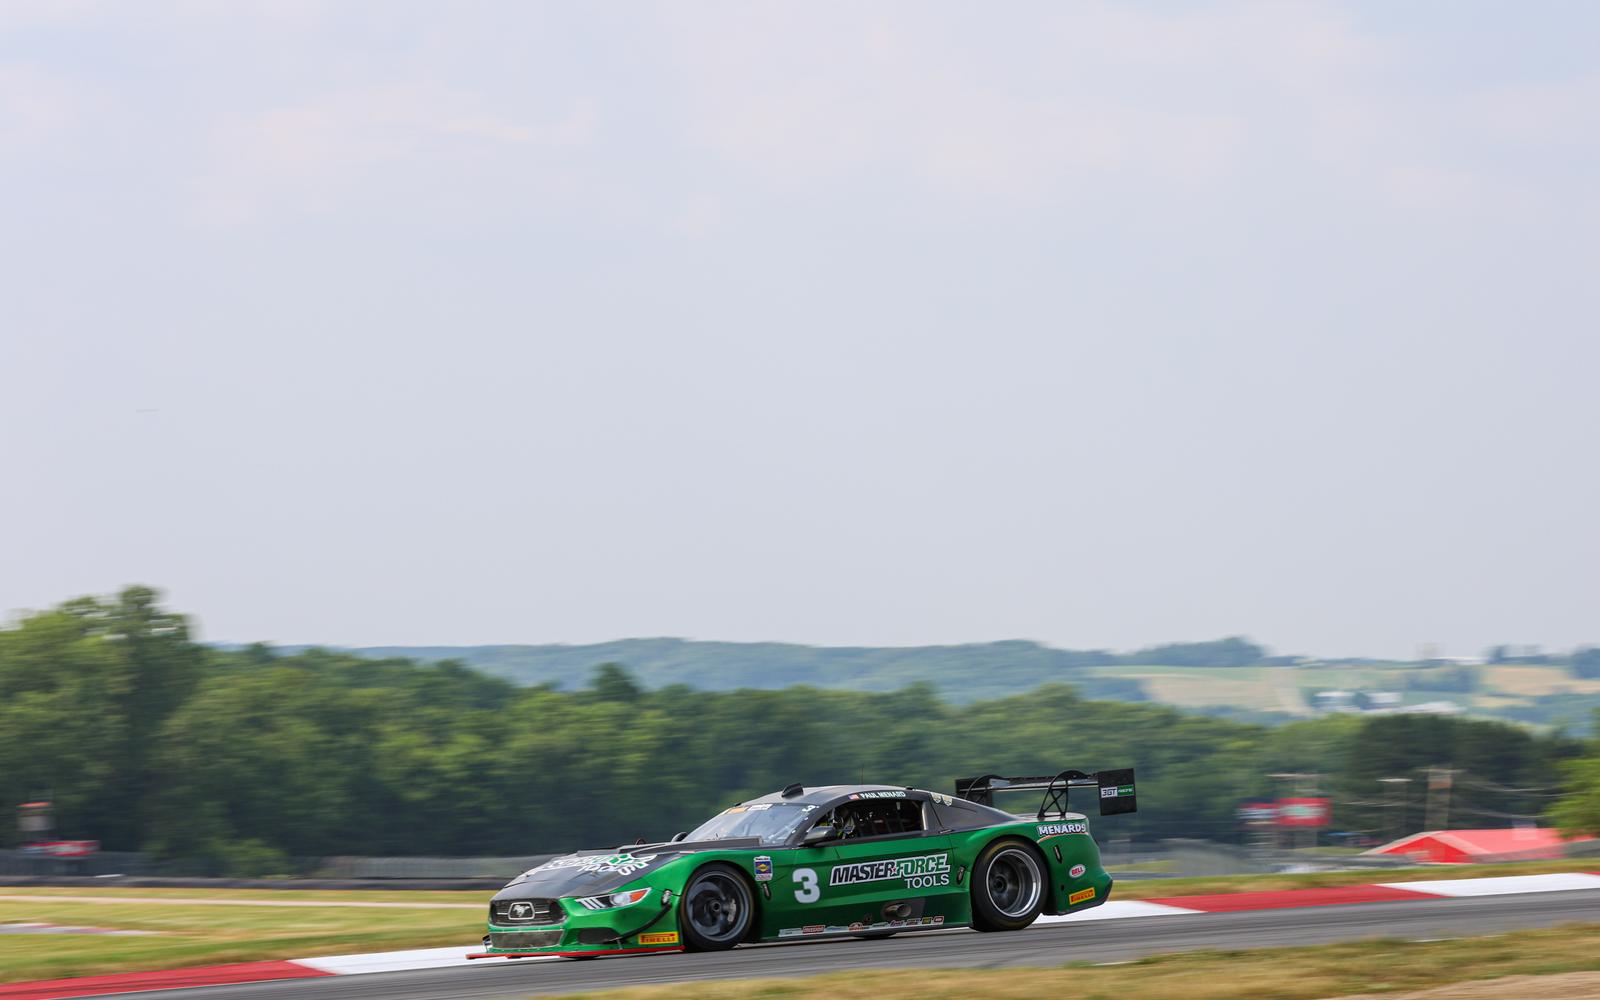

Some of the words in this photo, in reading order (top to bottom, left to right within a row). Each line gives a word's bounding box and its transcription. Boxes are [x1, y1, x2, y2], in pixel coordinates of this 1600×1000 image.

[1037, 823, 1087, 836] MENARDS
[831, 855, 950, 884] MASTERFORCE
[1071, 866, 1083, 876] BELL
[792, 868, 821, 904] 3
[904, 874, 950, 889] TOOLS
[640, 933, 677, 944] PIRELLI
